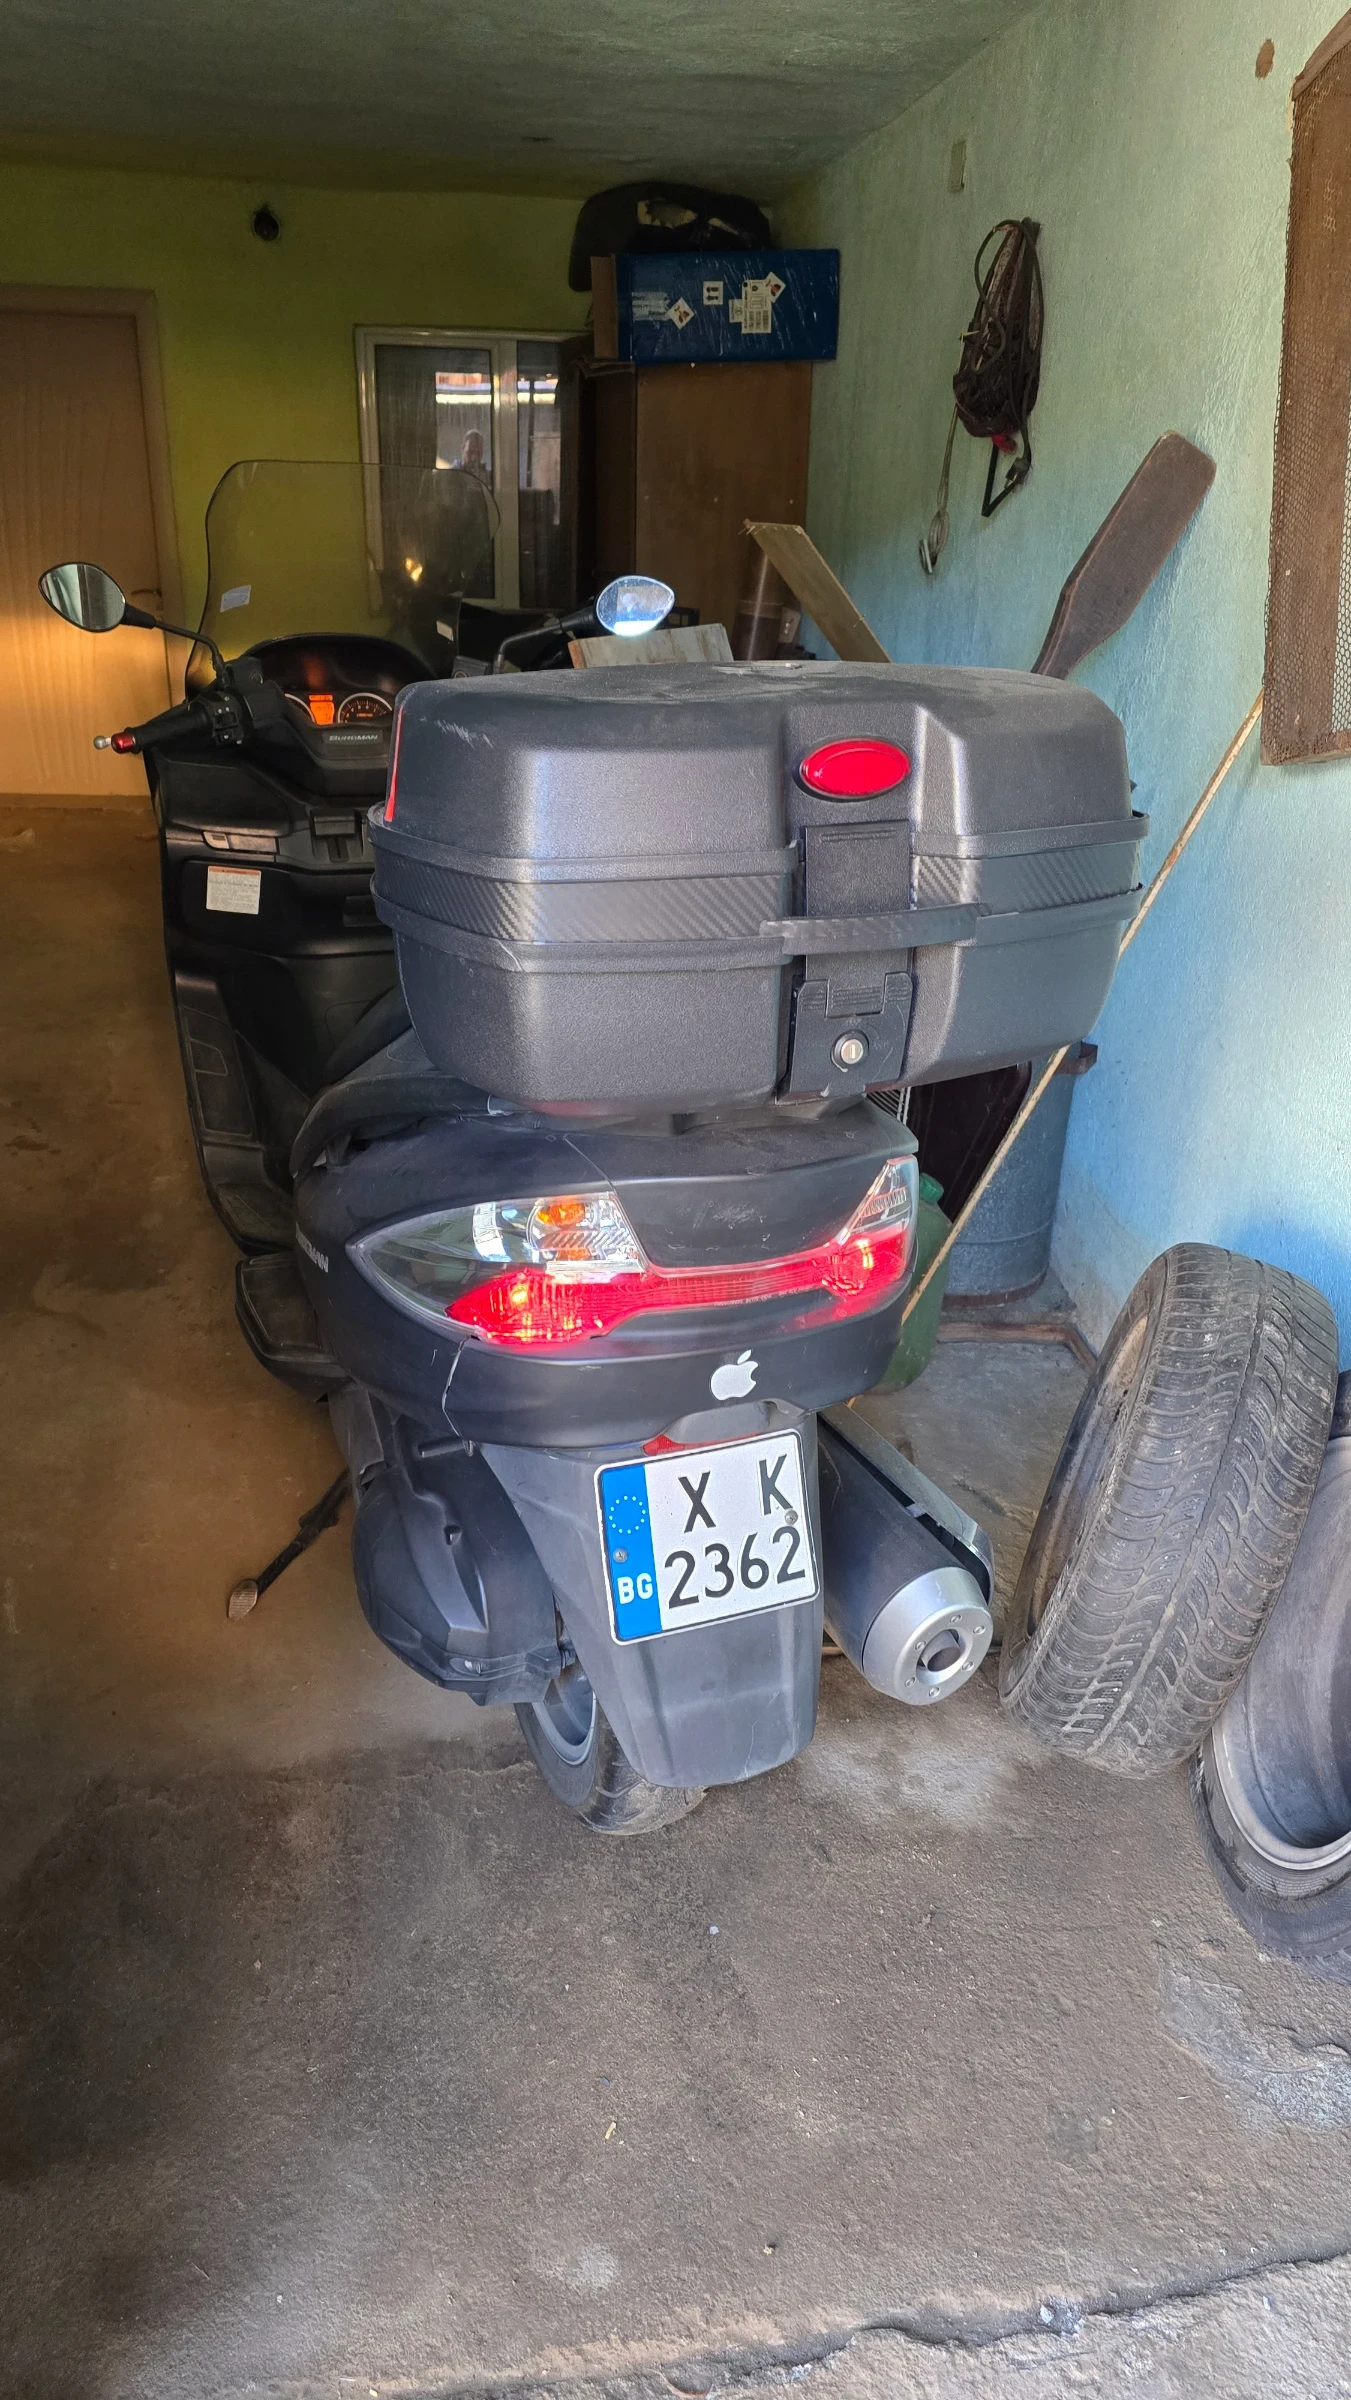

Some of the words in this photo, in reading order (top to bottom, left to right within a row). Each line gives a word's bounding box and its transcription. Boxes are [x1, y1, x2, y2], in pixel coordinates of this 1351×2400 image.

[678, 1470, 716, 1533] X
[758, 1454, 793, 1516] K
[617, 1573, 653, 1604] BG
[664, 1526, 805, 1609] 2362
